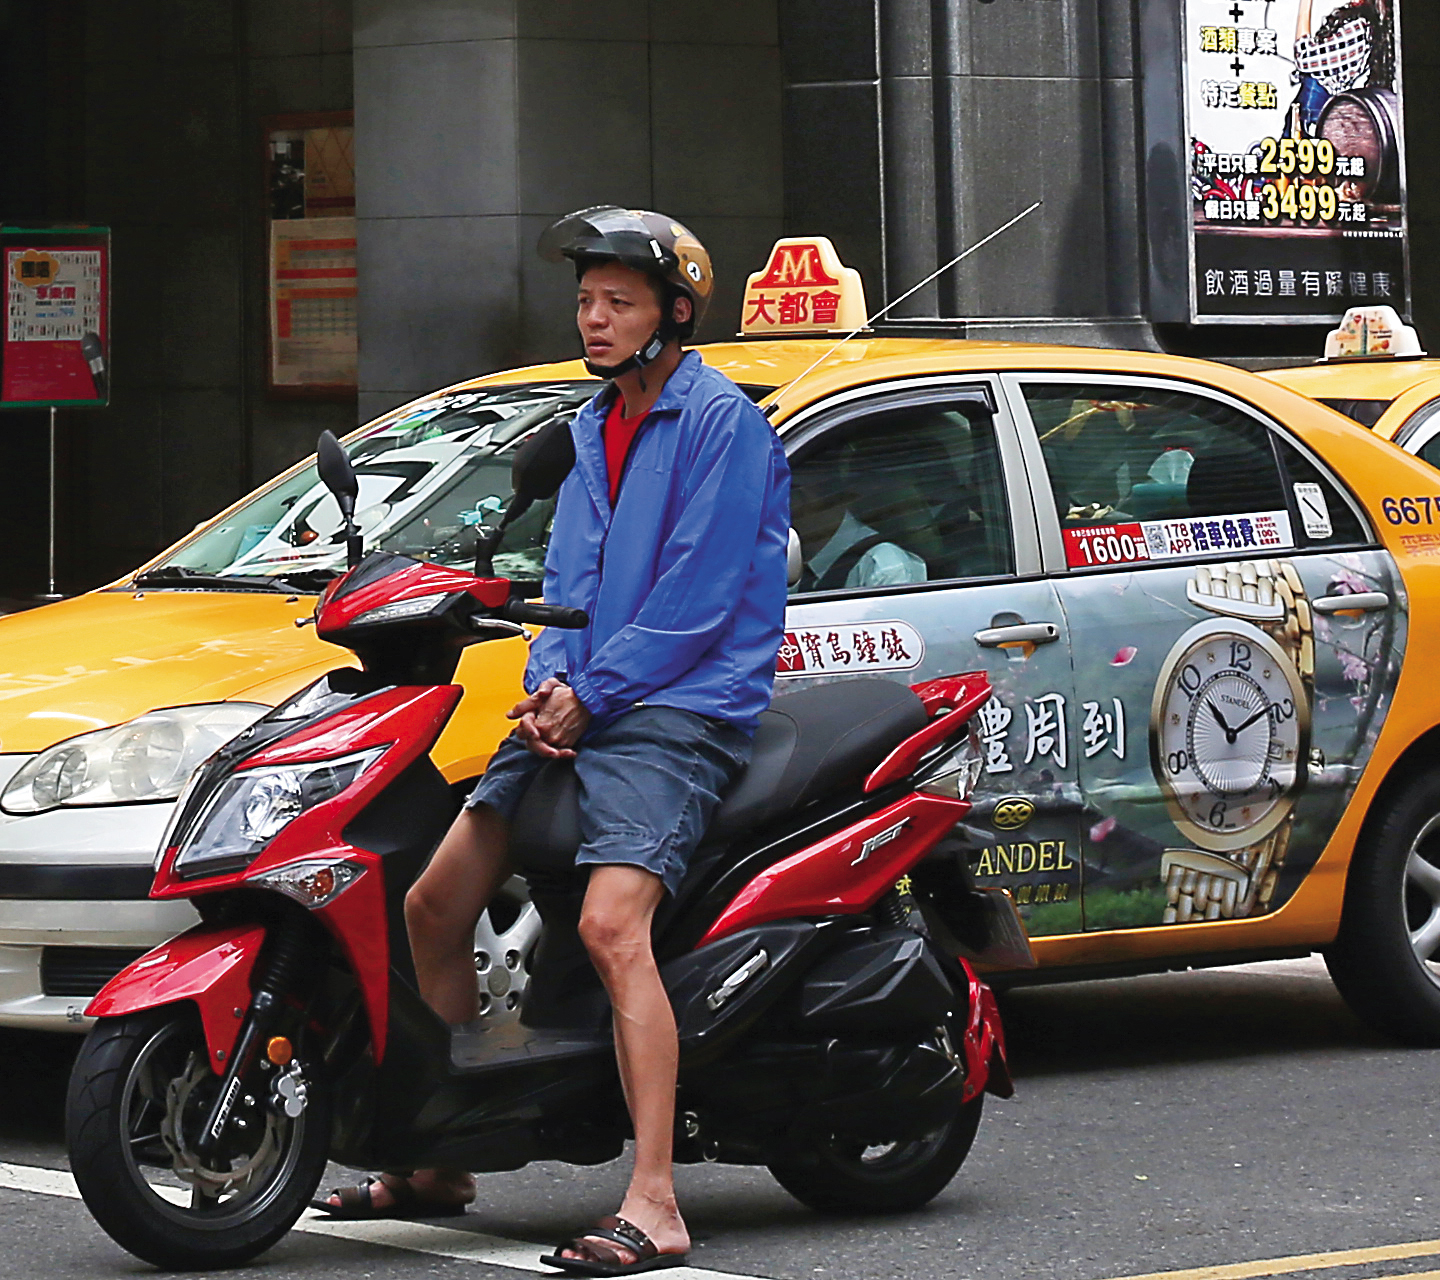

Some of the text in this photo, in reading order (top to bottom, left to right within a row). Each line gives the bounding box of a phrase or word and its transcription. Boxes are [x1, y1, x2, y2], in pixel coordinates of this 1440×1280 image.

[1200, 26, 1277, 55] 酒類專案
[1201, 79, 1277, 110] 特定餐點
[1204, 269, 1392, 298] 飲酒過量有礙健康
[745, 290, 842, 326] 大都會
[1163, 523, 1189, 539] 178
[1189, 518, 1258, 551] 搭車免費
[1170, 539, 1193, 555] APP
[800, 627, 912, 670] 寶島鐘錶
[1227, 641, 1252, 673] 12
[1177, 663, 1202, 703] 10
[1219, 693, 1251, 711] STANDEL
[1272, 697, 1294, 725] 2
[1167, 749, 1189, 776] 8
[1209, 801, 1228, 828] 6
